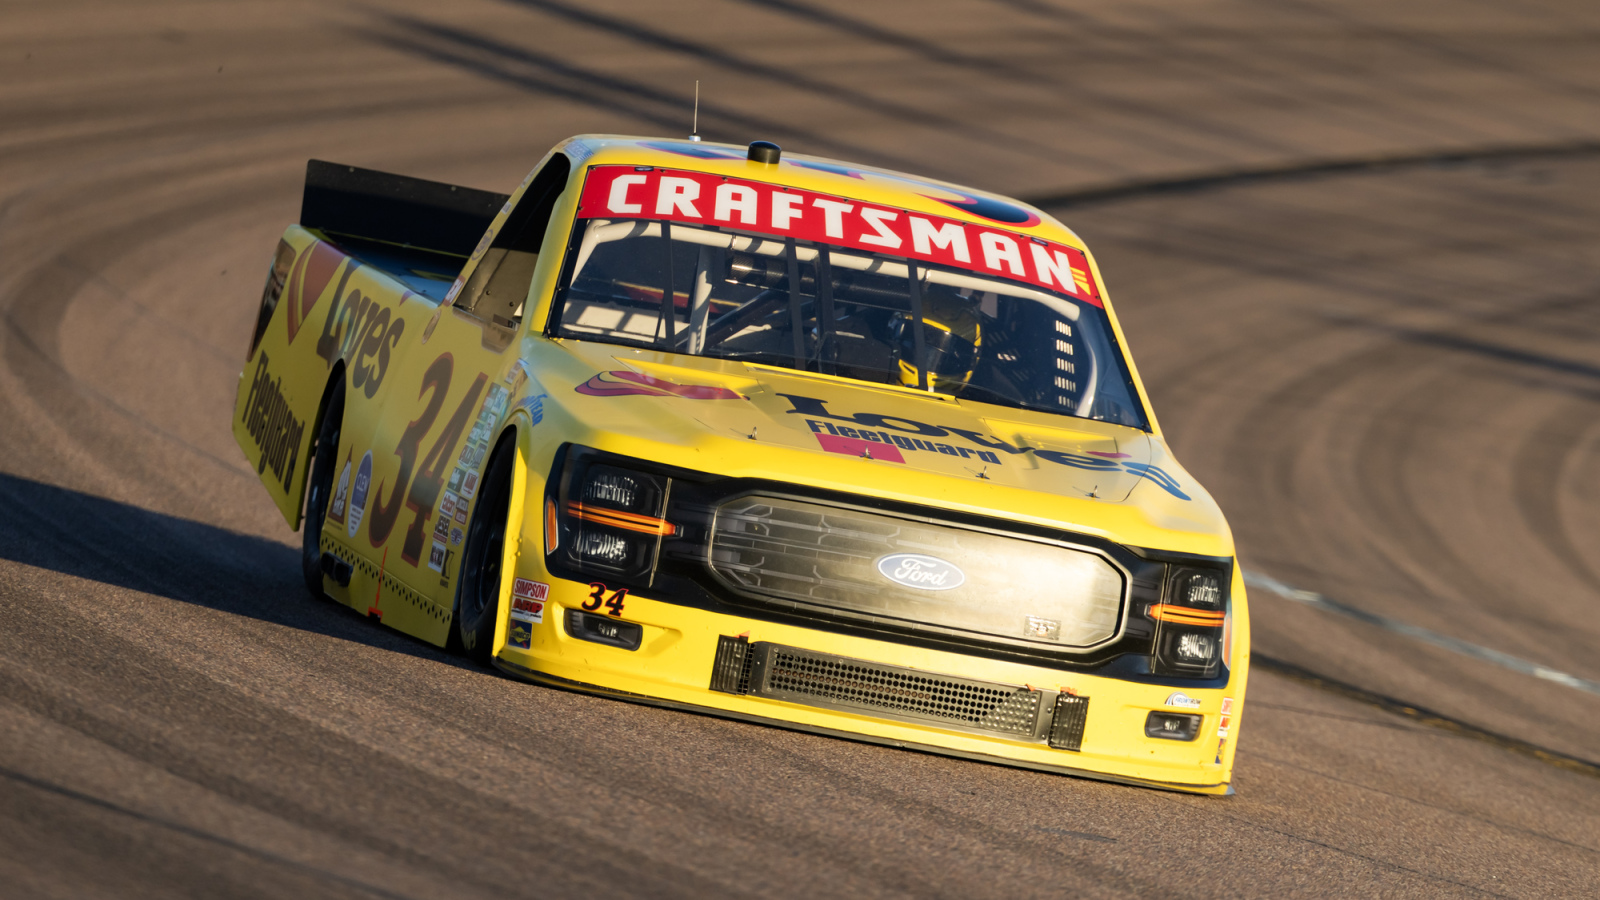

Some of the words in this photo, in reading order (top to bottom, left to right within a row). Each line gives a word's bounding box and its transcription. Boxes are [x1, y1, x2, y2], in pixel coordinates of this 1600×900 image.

[607, 173, 1078, 295] CRAFTSMAN
[805, 418, 1003, 465] Fleetguard
[369, 352, 488, 568] 34
[515, 579, 547, 599] SIMPSON
[894, 558, 950, 586] Ford
[513, 598, 543, 613] ARP
[582, 582, 629, 617] 34
